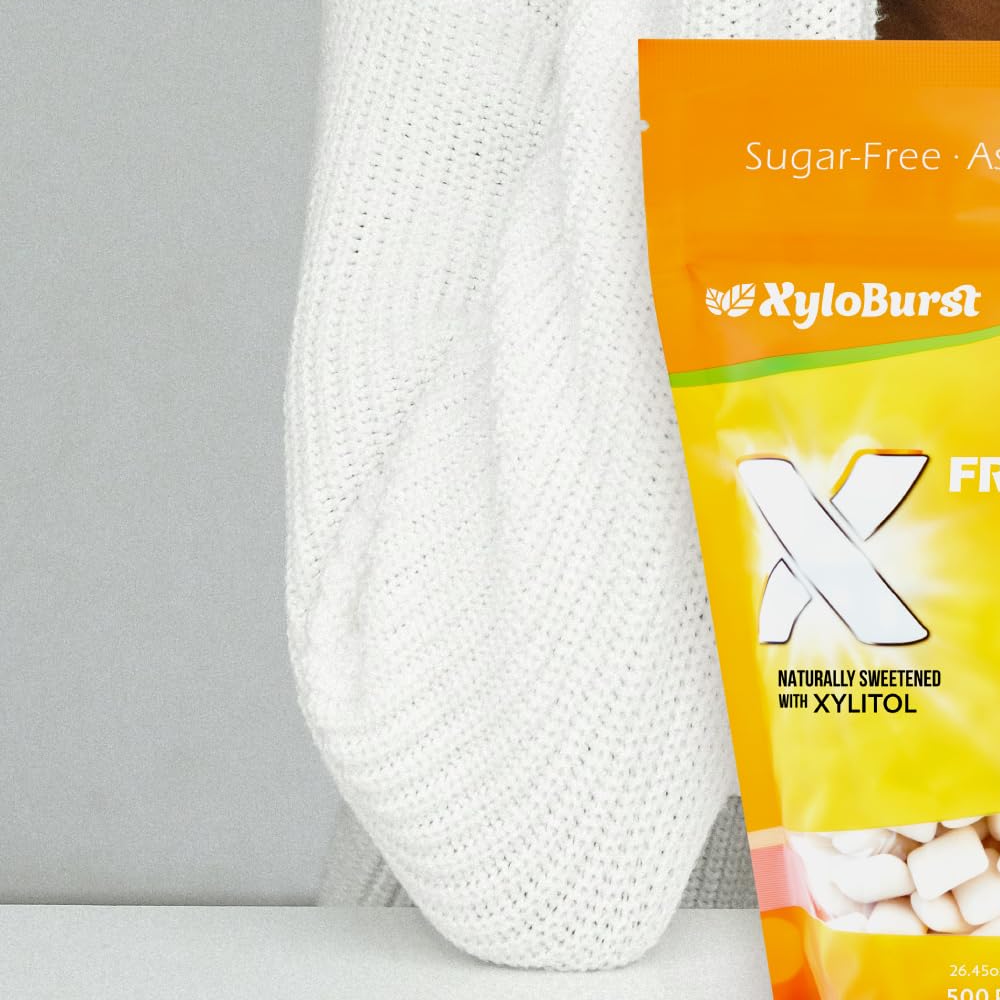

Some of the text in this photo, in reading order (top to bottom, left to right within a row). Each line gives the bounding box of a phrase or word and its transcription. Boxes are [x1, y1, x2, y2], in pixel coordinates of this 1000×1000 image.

[747, 141, 942, 180] Sugar-Free
[759, 281, 982, 330] XyloBurst
[736, 448, 931, 647] X
[778, 669, 941, 687] NATURALLY SWEETENED
[778, 692, 918, 714] WITH XYLITOL
[946, 988, 990, 1000] 500
